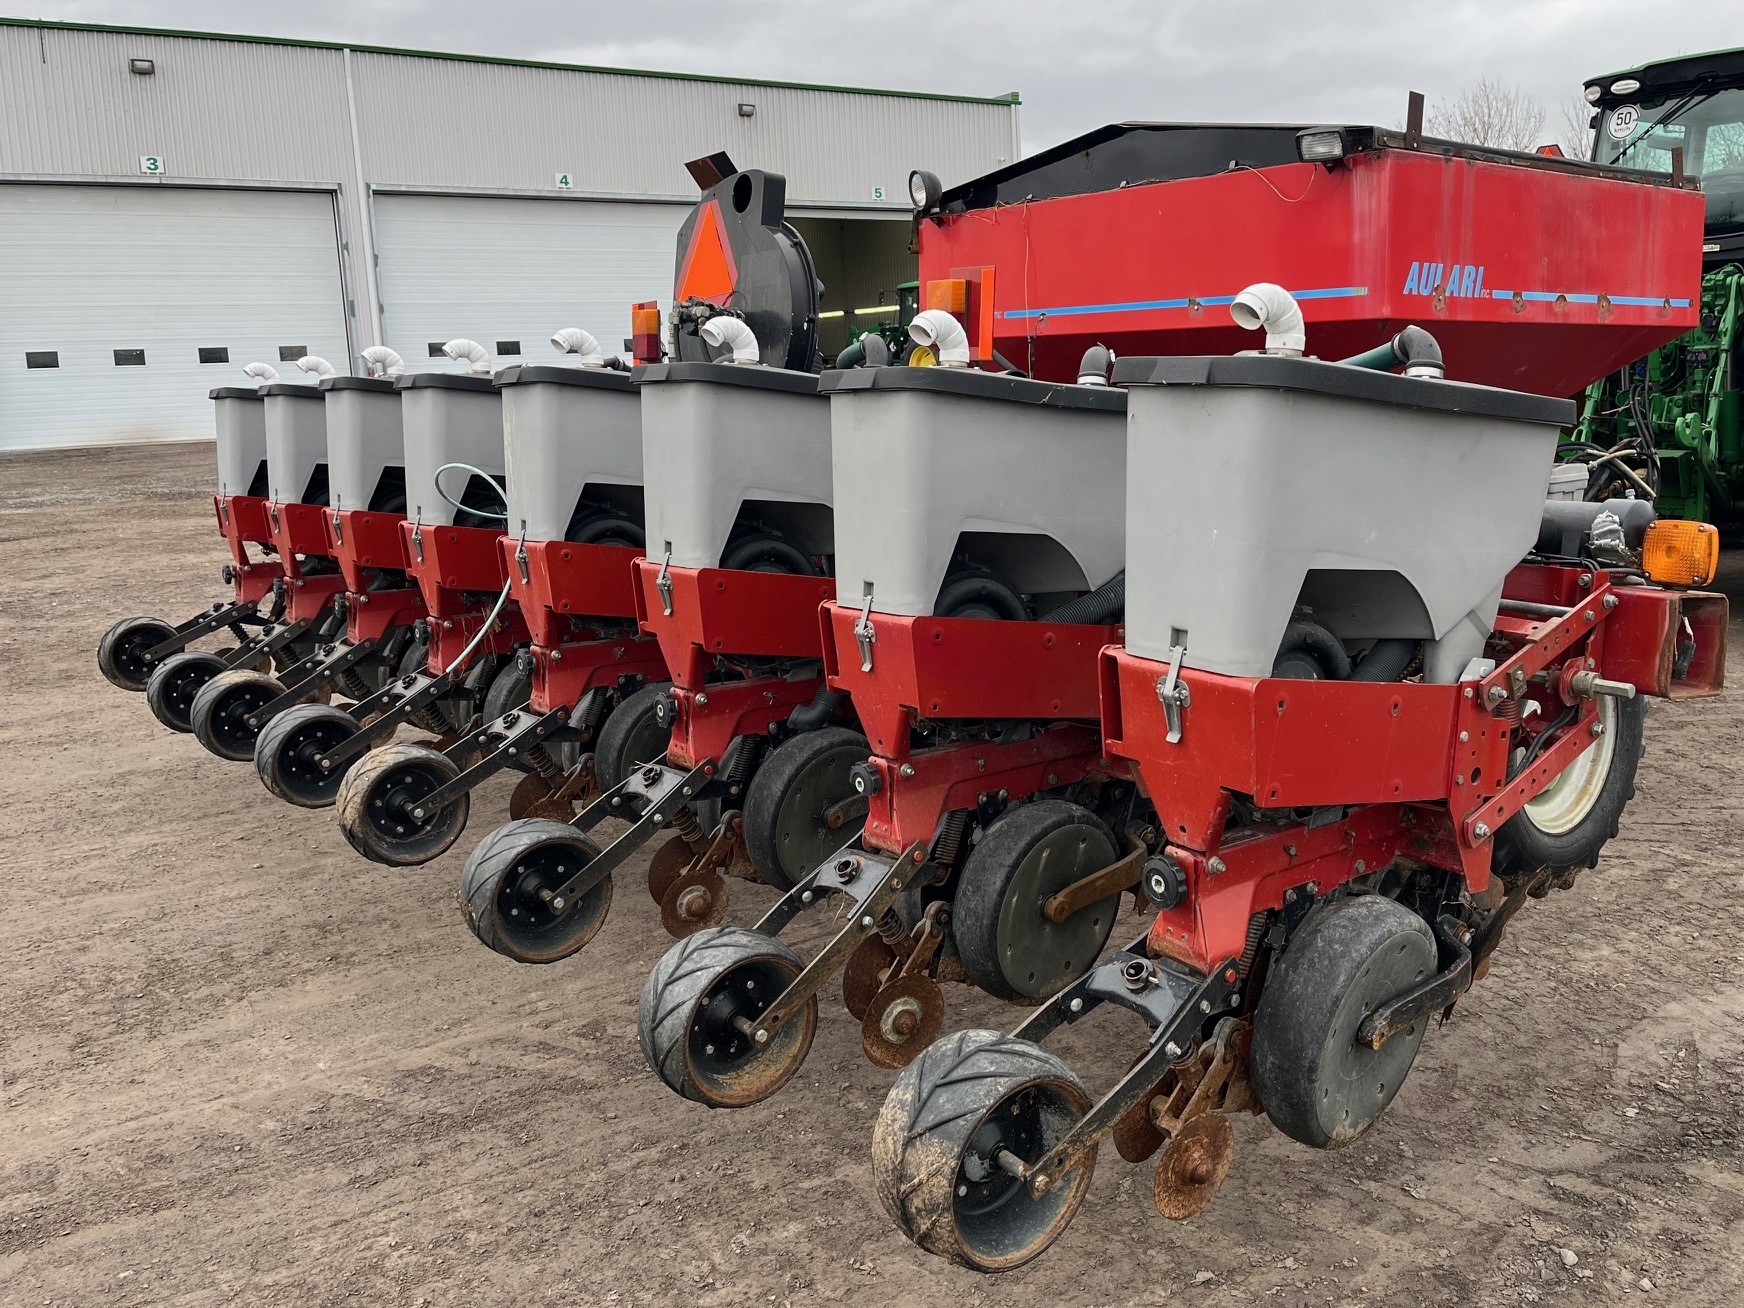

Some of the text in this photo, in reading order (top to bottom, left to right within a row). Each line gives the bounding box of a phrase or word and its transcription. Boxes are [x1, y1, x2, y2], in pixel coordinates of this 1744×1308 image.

[1616, 111, 1632, 126] 50
[145, 157, 159, 171] 3
[559, 174, 570, 187] 4
[874, 187, 882, 199] 5
